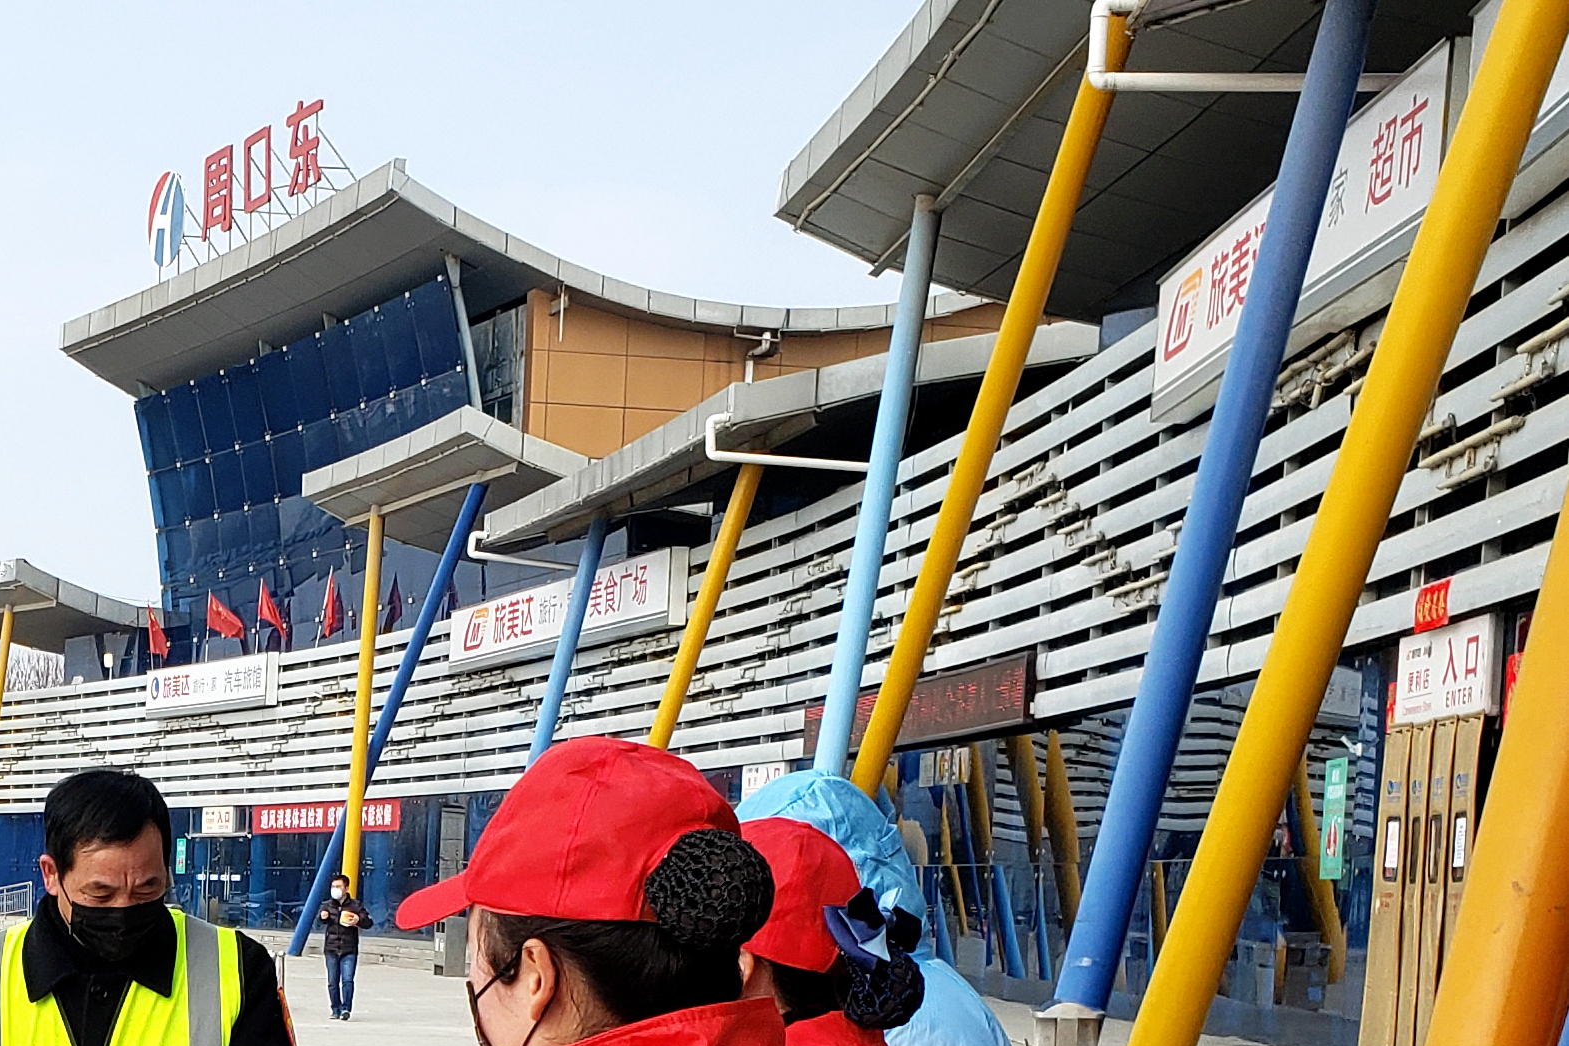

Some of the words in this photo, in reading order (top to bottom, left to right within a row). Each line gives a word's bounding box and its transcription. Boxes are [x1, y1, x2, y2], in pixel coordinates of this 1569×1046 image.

[202, 99, 324, 242] 周口东
[1206, 222, 1266, 330] 旅美
[1365, 94, 1428, 214] 超市
[493, 594, 534, 643] 旅美达
[589, 564, 648, 618] 美食广场
[1442, 634, 1480, 686] 入口
[162, 674, 190, 699] 旅美达
[224, 665, 262, 693] 汽车旅馆
[1406, 667, 1431, 694] 便利店
[1445, 686, 1473, 709] ENTER
[217, 811, 230, 823] 入口
[260, 807, 323, 829] 通风消毒体温检测
